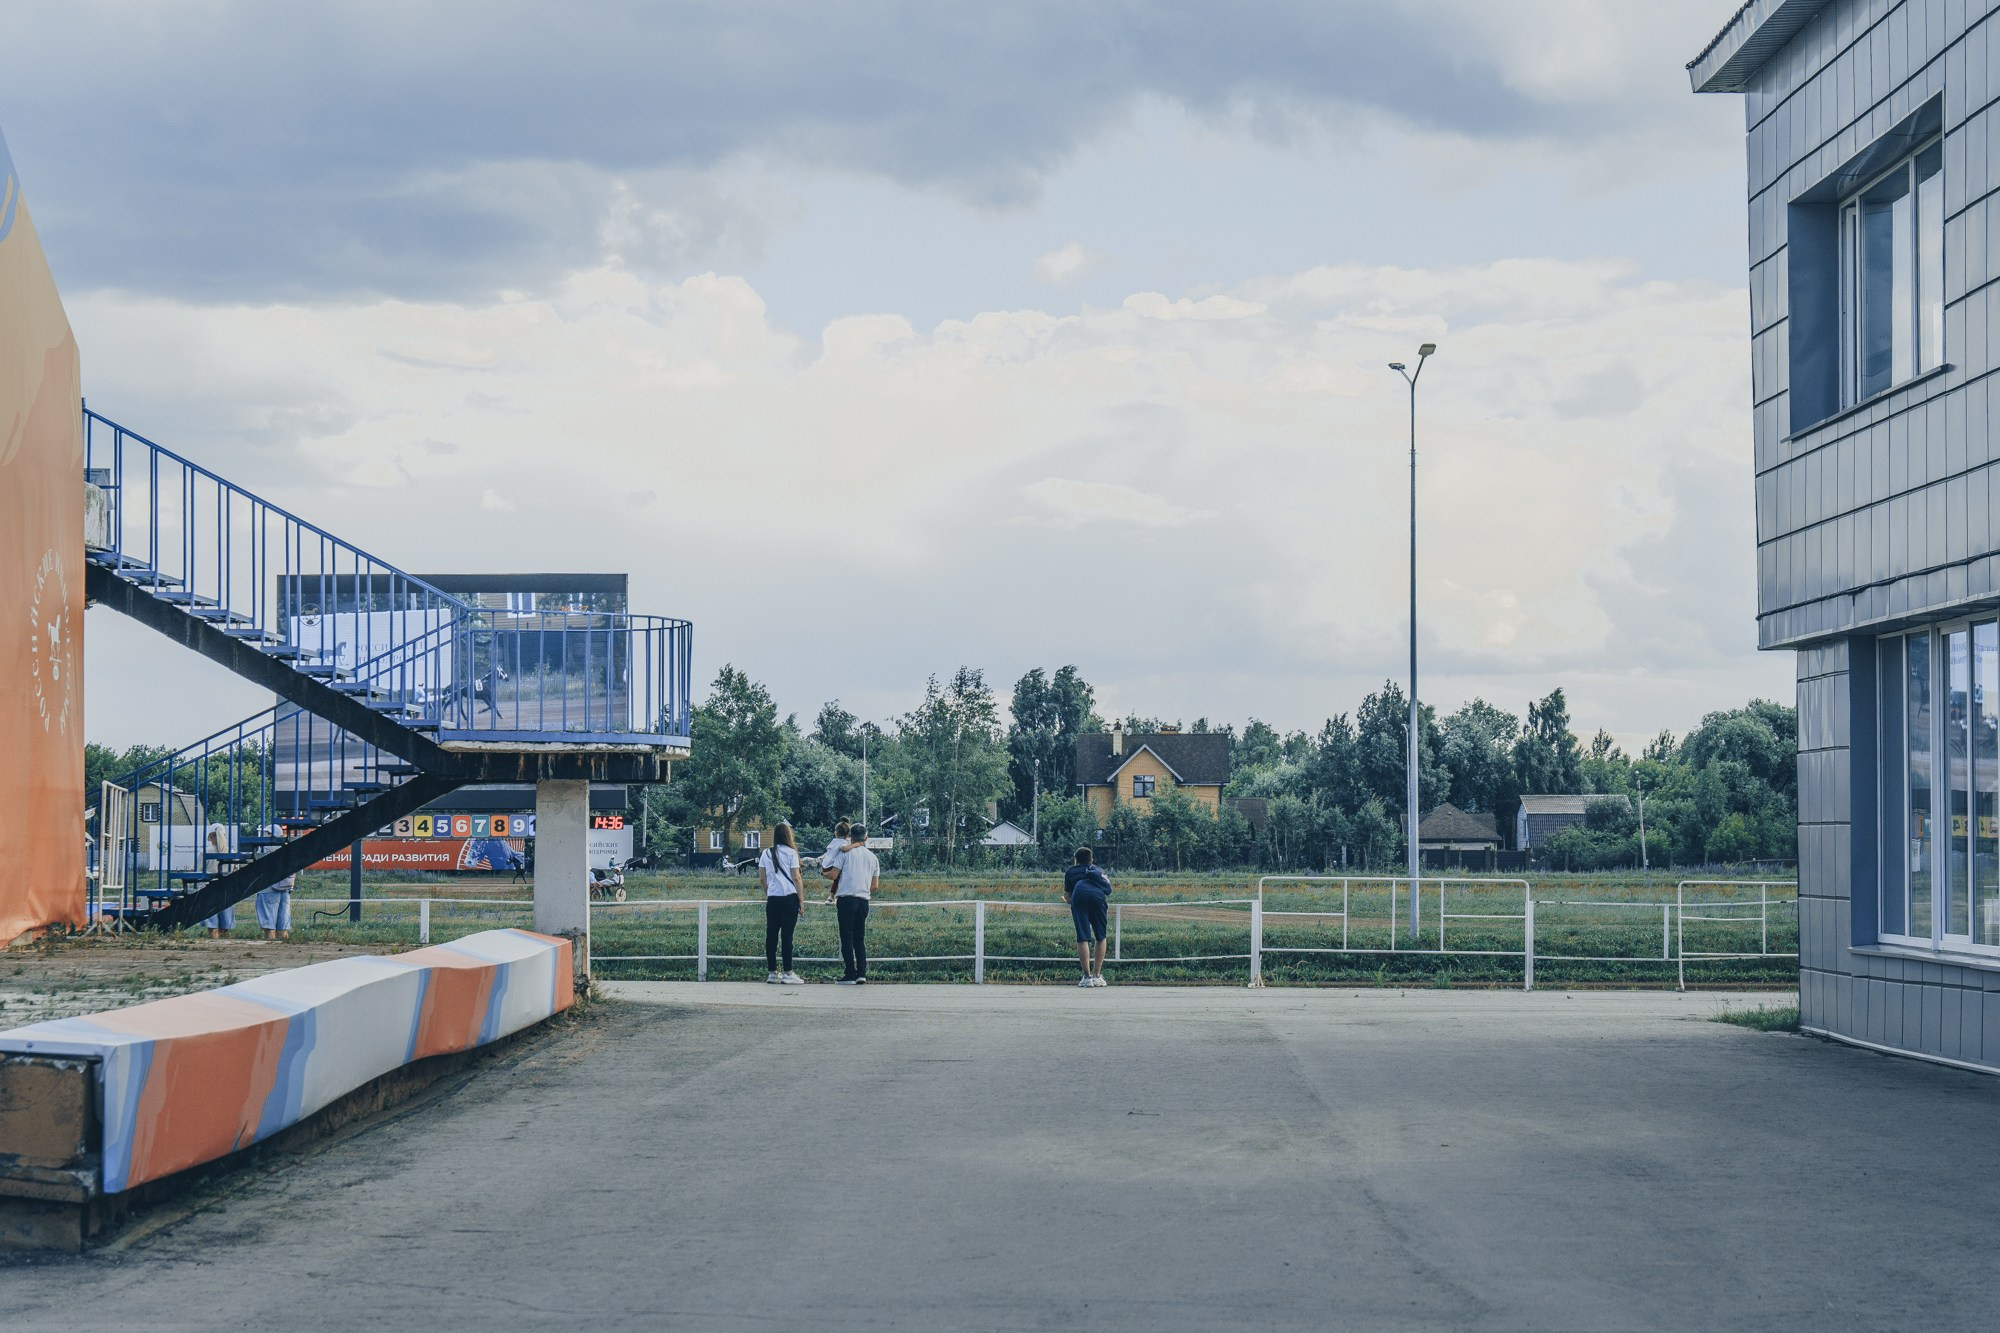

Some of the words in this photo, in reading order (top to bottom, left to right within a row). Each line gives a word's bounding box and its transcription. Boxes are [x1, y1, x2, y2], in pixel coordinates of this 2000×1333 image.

[398, 819, 410, 833] 3
[417, 819, 430, 832] 4
[436, 819, 449, 833] 5
[455, 819, 468, 833] 6
[474, 819, 487, 833] 7
[493, 819, 506, 833] 8
[512, 819, 526, 833] 9
[529, 819, 536, 832] 1
[594, 816, 624, 830] 14:36
[589, 840, 618, 848] СИЙСКИЕ
[322, 853, 352, 862] ЕНИ
[361, 853, 389, 863] РАДИ
[391, 853, 450, 862] РАЗВИТИЯ
